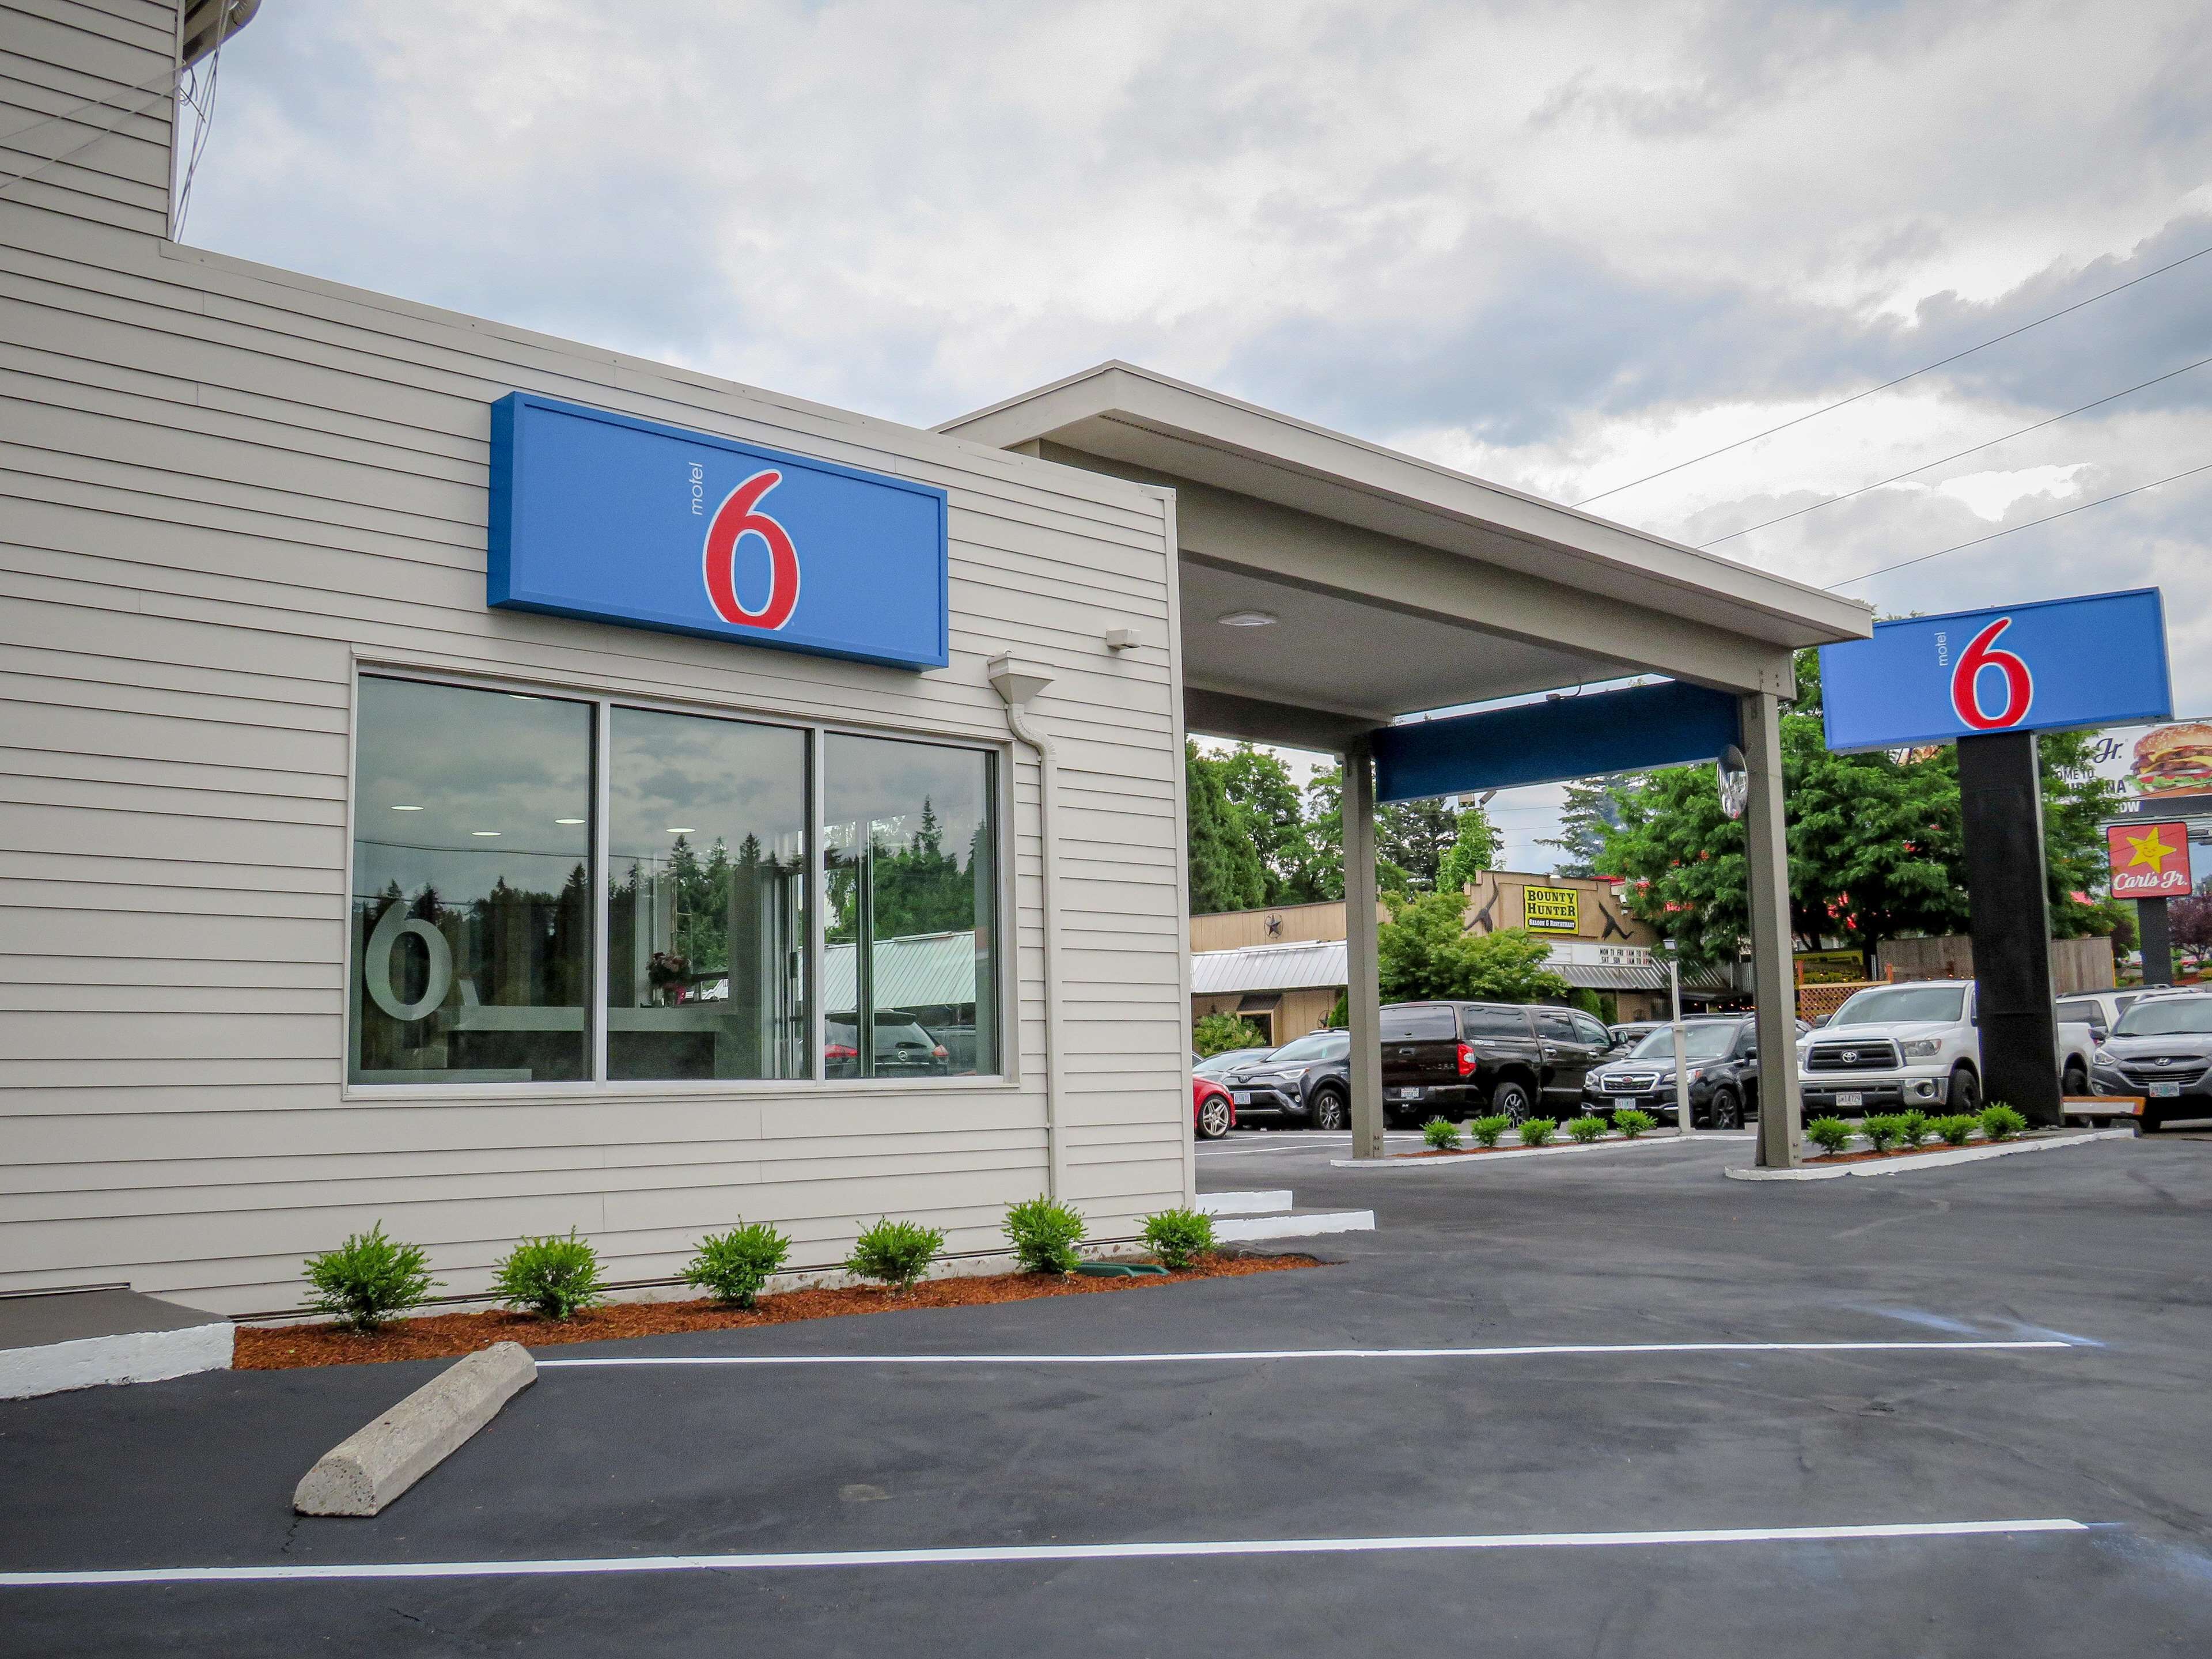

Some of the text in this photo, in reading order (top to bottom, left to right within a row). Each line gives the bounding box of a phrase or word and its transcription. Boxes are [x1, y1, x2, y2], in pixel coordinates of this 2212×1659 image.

[688, 462, 703, 516] motel
[702, 468, 801, 631] 6
[1934, 632, 1948, 666] motel
[1950, 616, 2034, 730] 6
[1527, 890, 1575, 904] BOUNTY
[2113, 870, 2188, 890] Carl's Jr.
[1527, 902, 1576, 916] HUNTER
